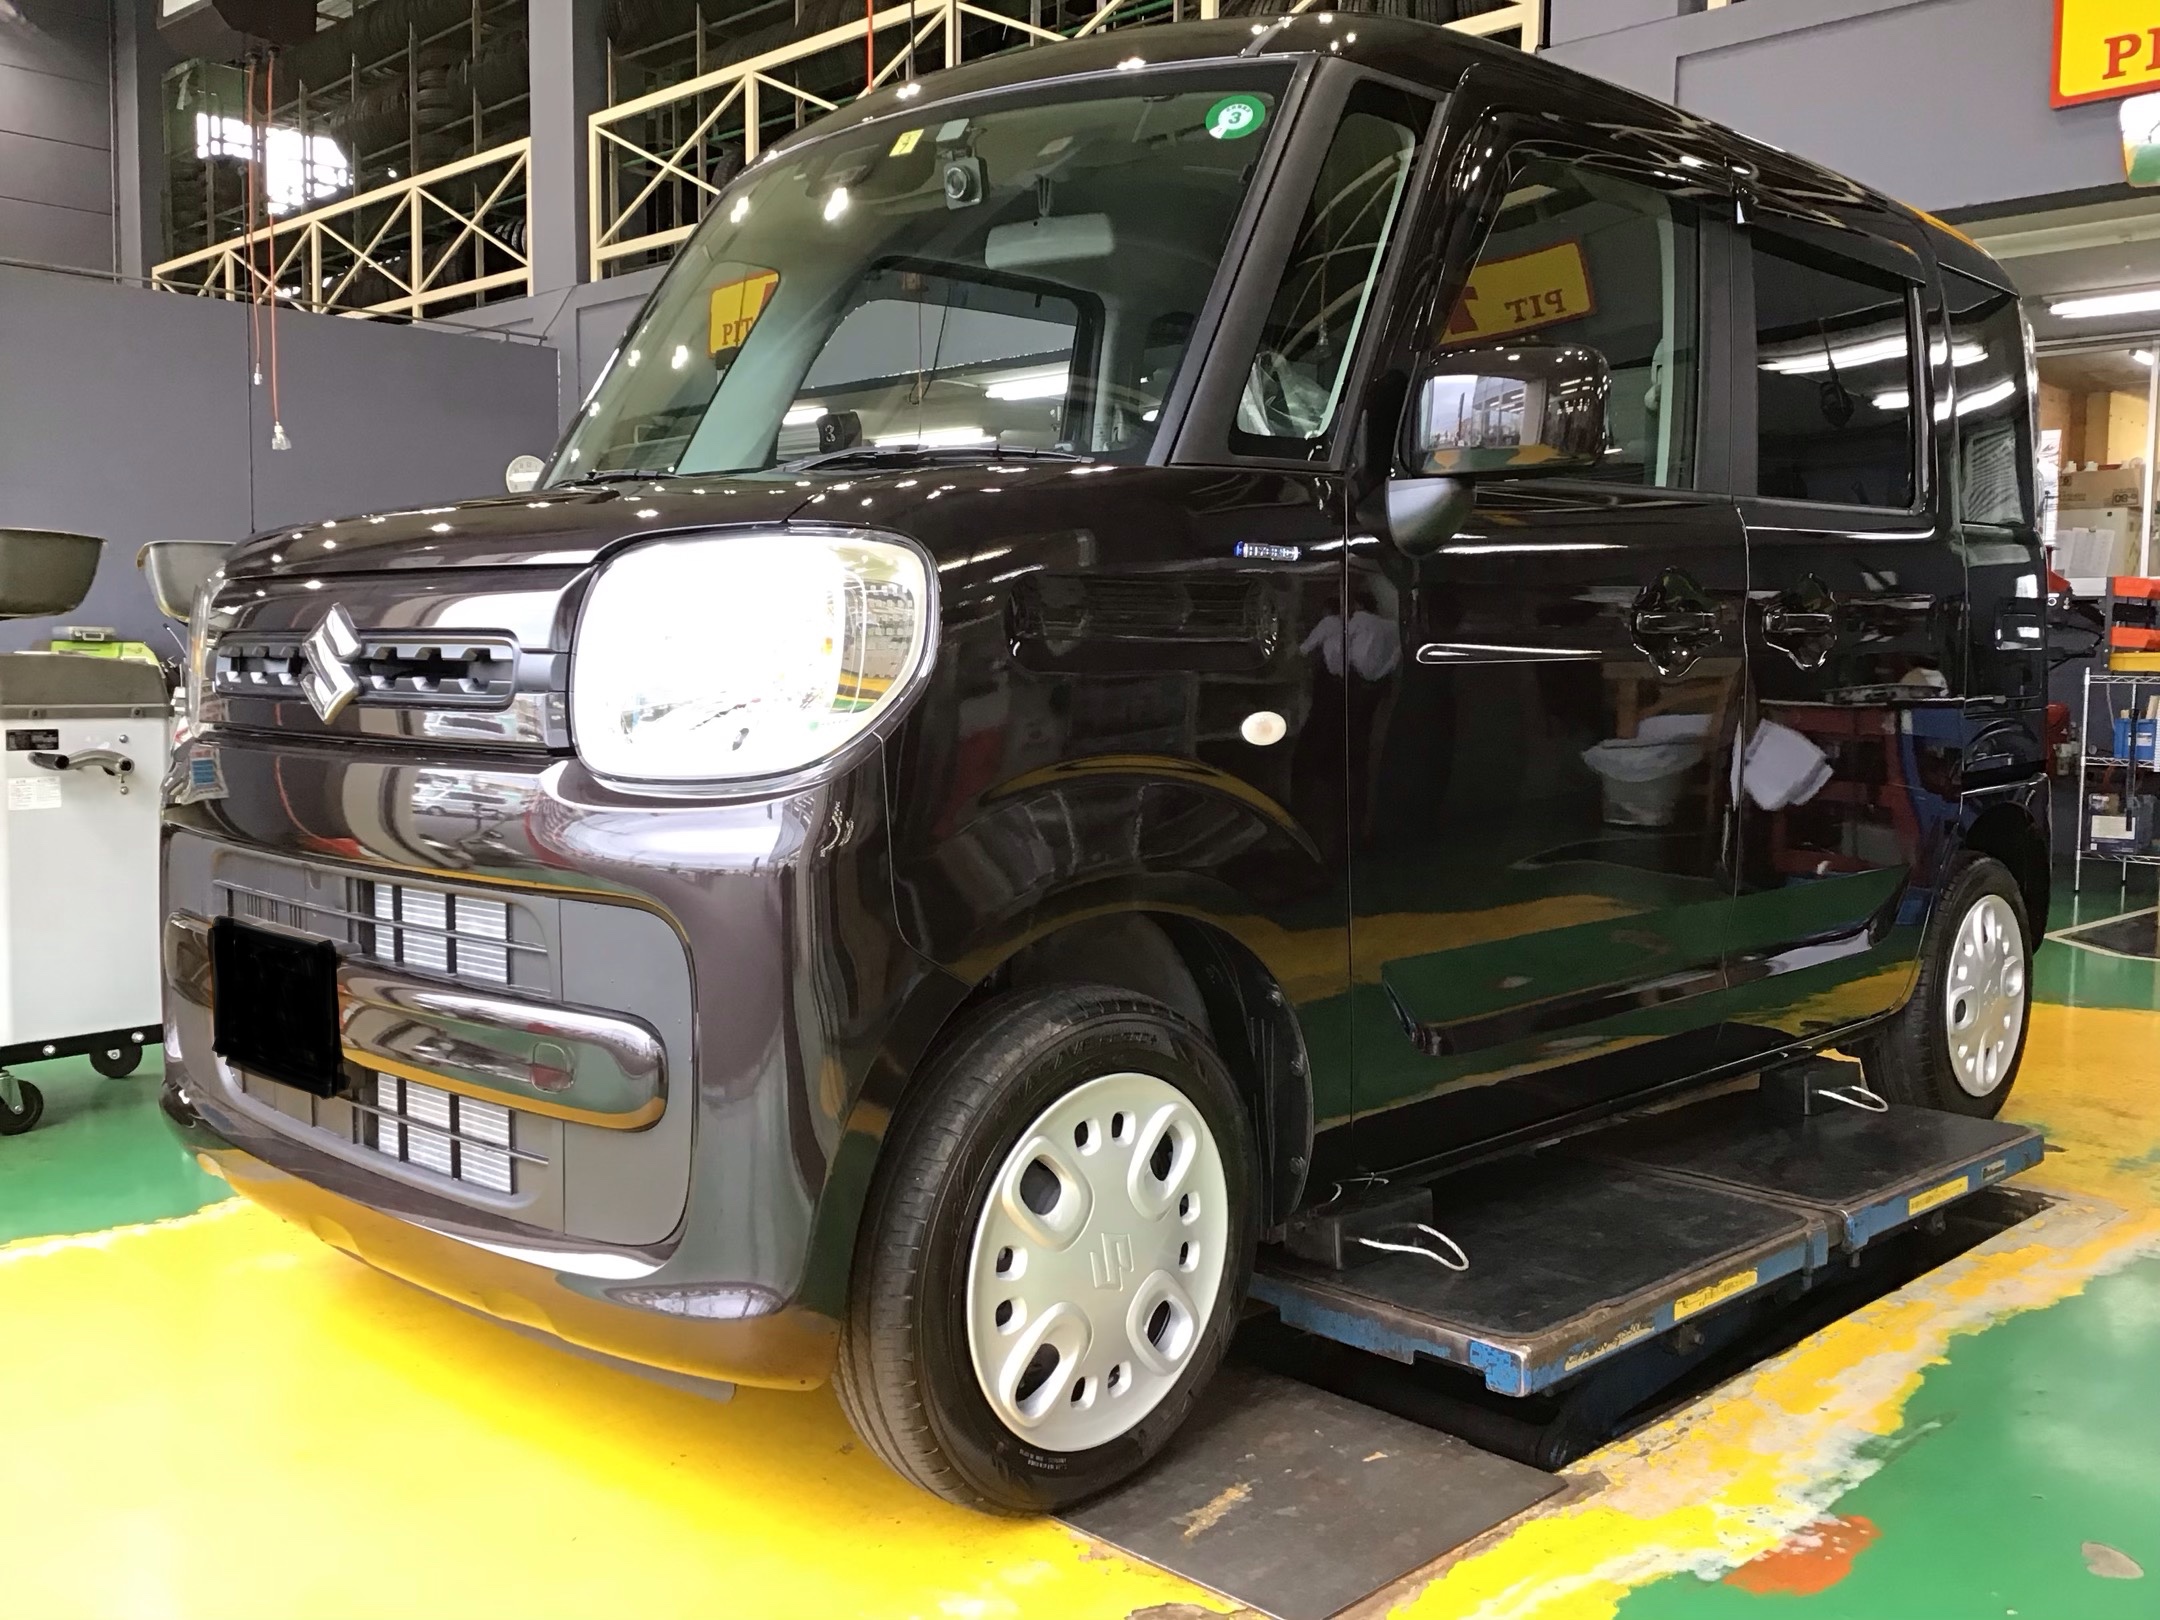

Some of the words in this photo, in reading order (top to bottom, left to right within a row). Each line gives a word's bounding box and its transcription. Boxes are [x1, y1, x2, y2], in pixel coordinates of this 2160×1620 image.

[1228, 111, 1242, 124] 3
[722, 316, 753, 346] PIT
[825, 424, 836, 442] 3
